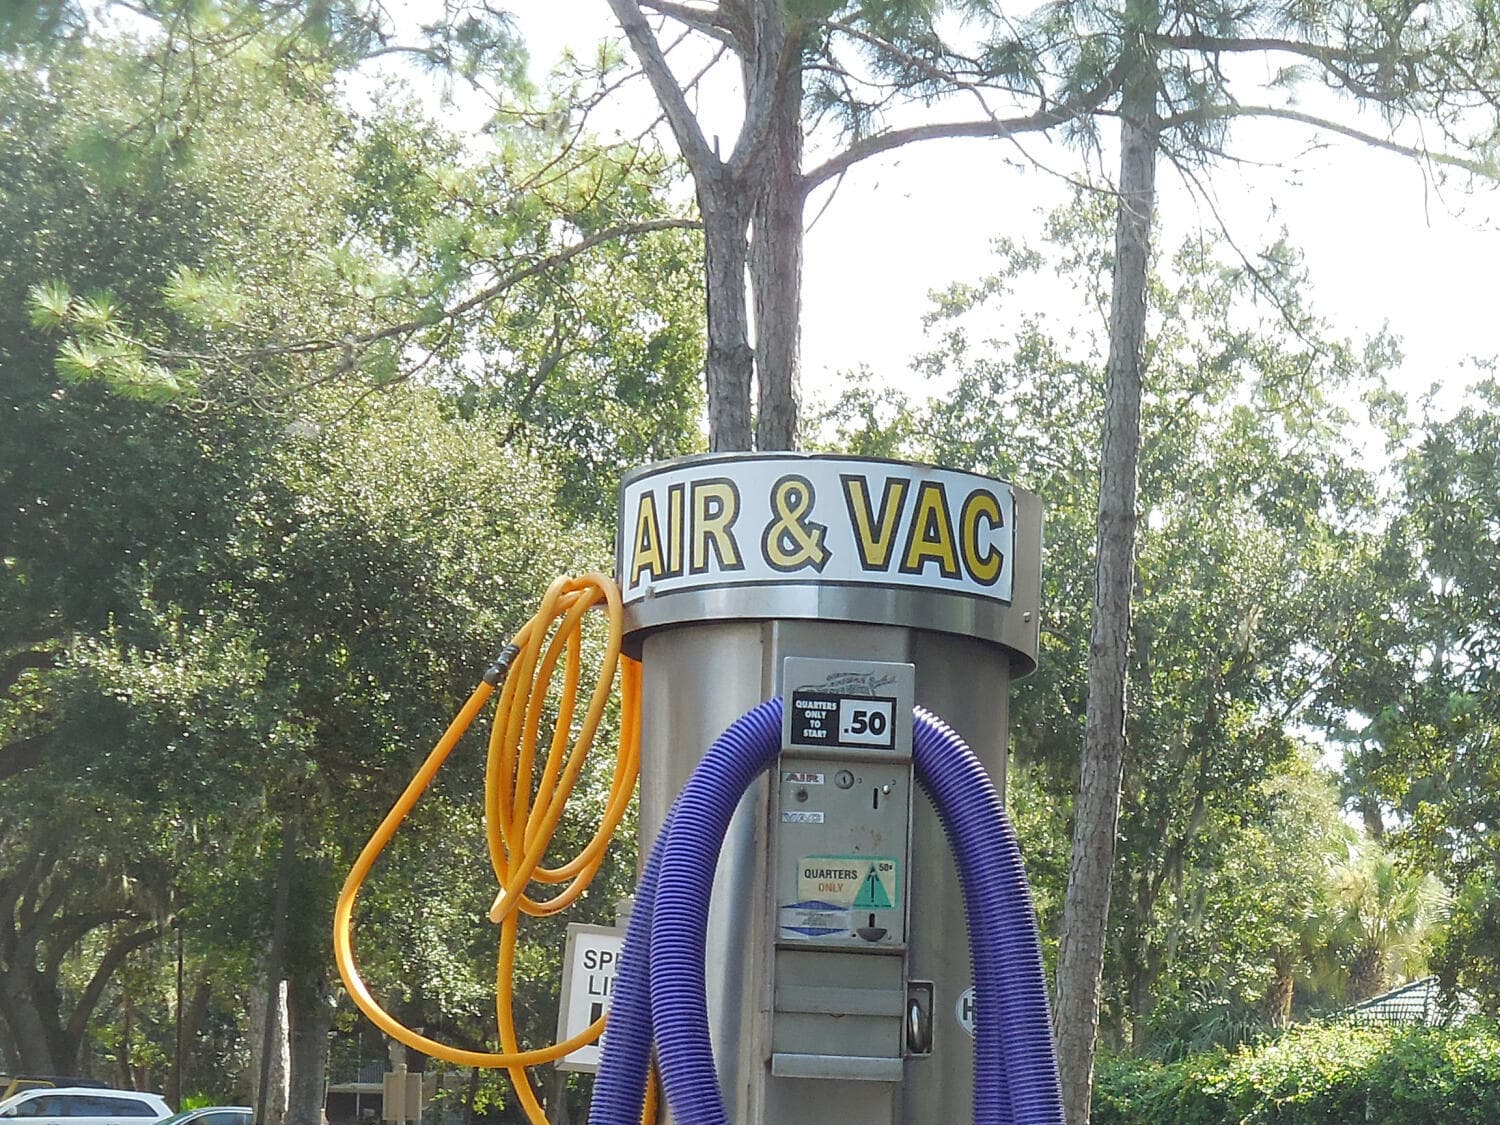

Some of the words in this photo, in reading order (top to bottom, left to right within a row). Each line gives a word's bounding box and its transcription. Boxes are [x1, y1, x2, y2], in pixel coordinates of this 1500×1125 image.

[628, 477, 745, 589] AIR
[760, 474, 832, 574] &
[839, 474, 1005, 587] VAC
[795, 700, 837, 711] QUARTERS
[804, 710, 827, 719] ONLY
[809, 719, 822, 729] TO
[843, 710, 887, 736] .50
[803, 729, 827, 739] START
[785, 773, 819, 783] AIR
[804, 869, 858, 880] QUARTERS
[818, 882, 844, 892] ONLY
